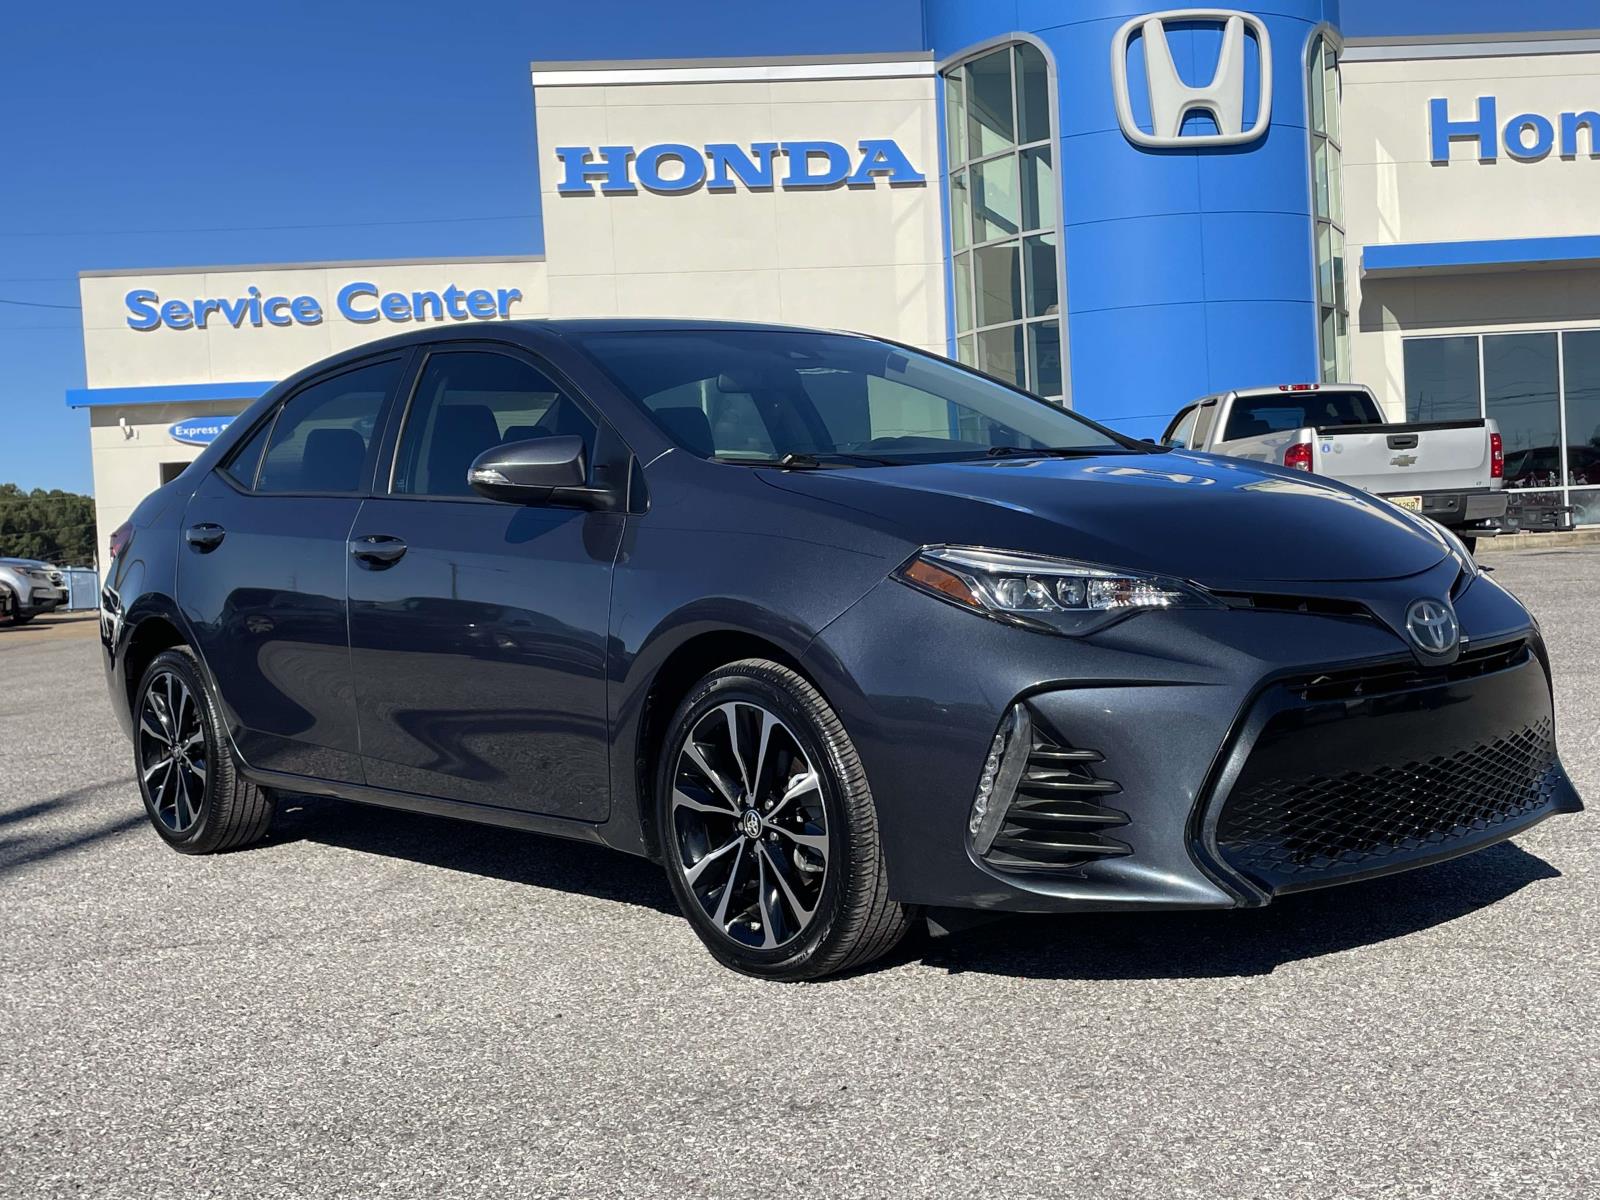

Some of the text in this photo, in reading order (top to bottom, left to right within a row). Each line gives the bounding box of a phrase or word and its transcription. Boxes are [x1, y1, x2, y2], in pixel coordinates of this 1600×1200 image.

[1428, 96, 1600, 162] Hon
[555, 139, 926, 195] HONDA
[125, 282, 523, 331] Service Center
[175, 426, 219, 437] Express
